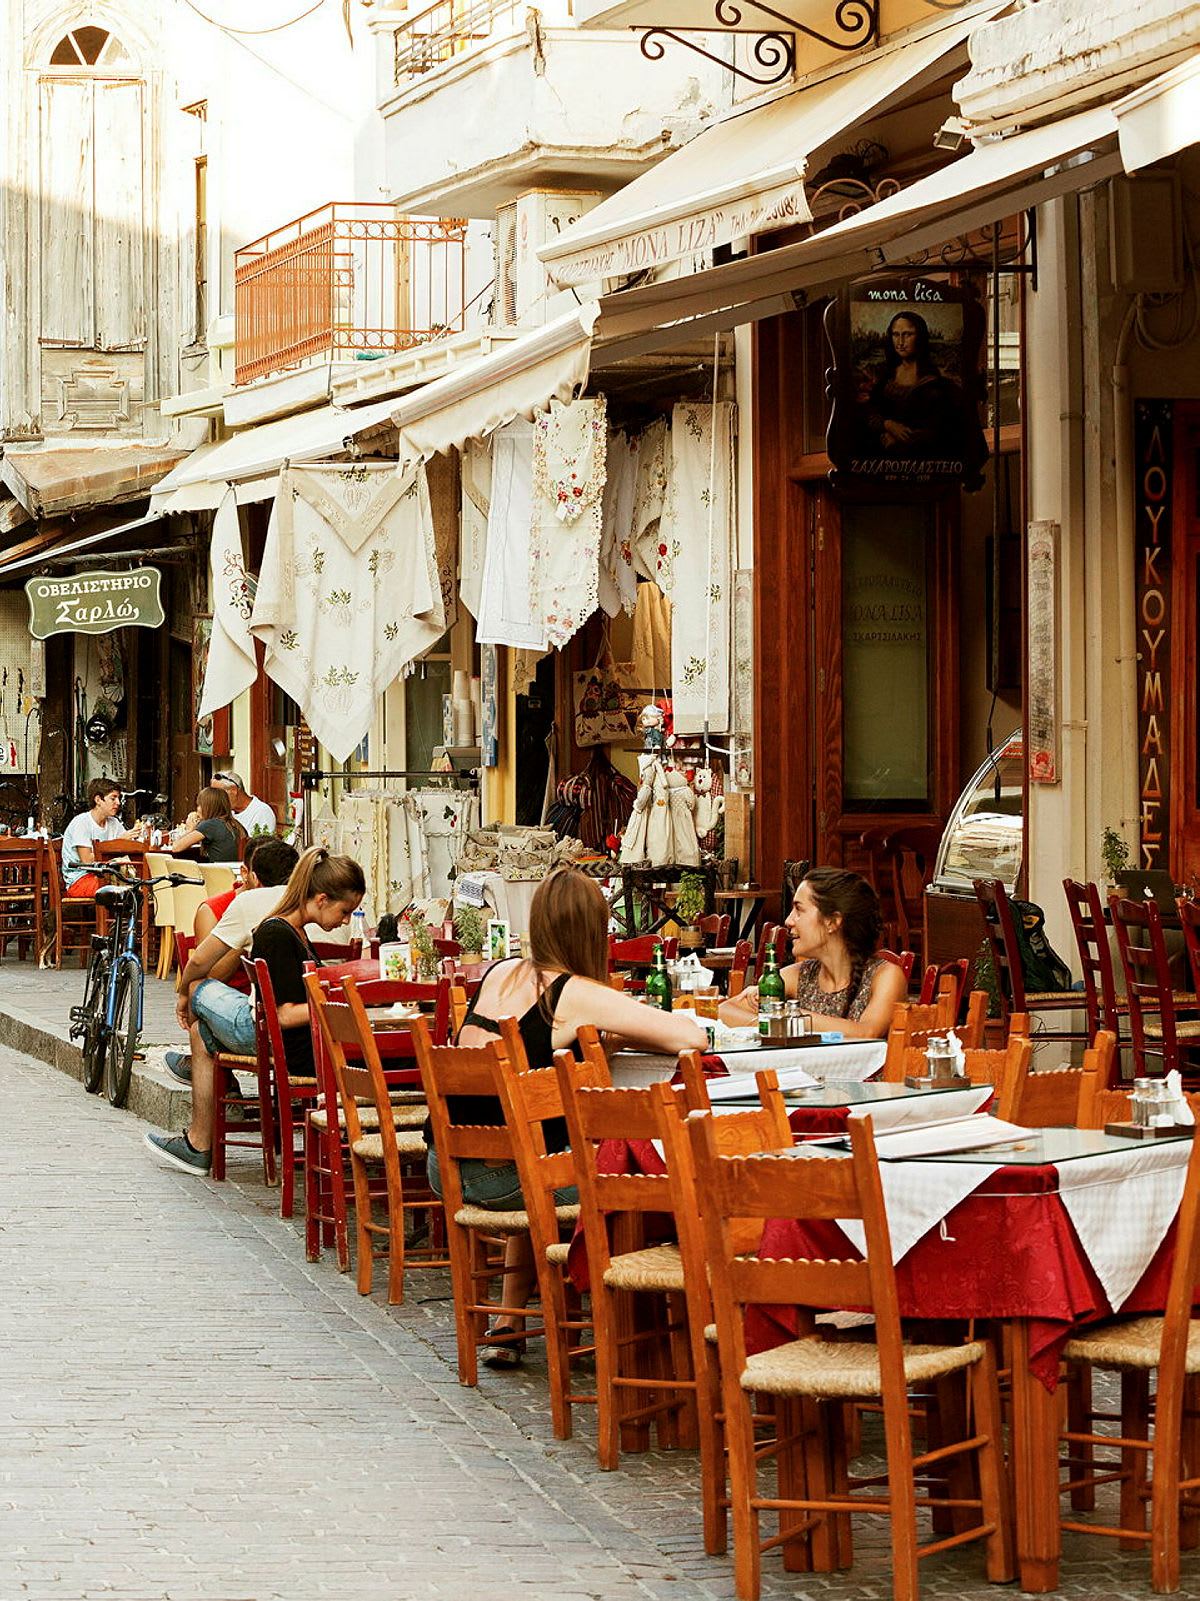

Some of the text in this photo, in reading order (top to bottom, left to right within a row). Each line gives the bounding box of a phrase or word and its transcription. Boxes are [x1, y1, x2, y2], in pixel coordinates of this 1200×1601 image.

[868, 282, 944, 302] mona lisa
[37, 576, 152, 598] ΟΒΕΛΙΣΤΗΡΙΟ
